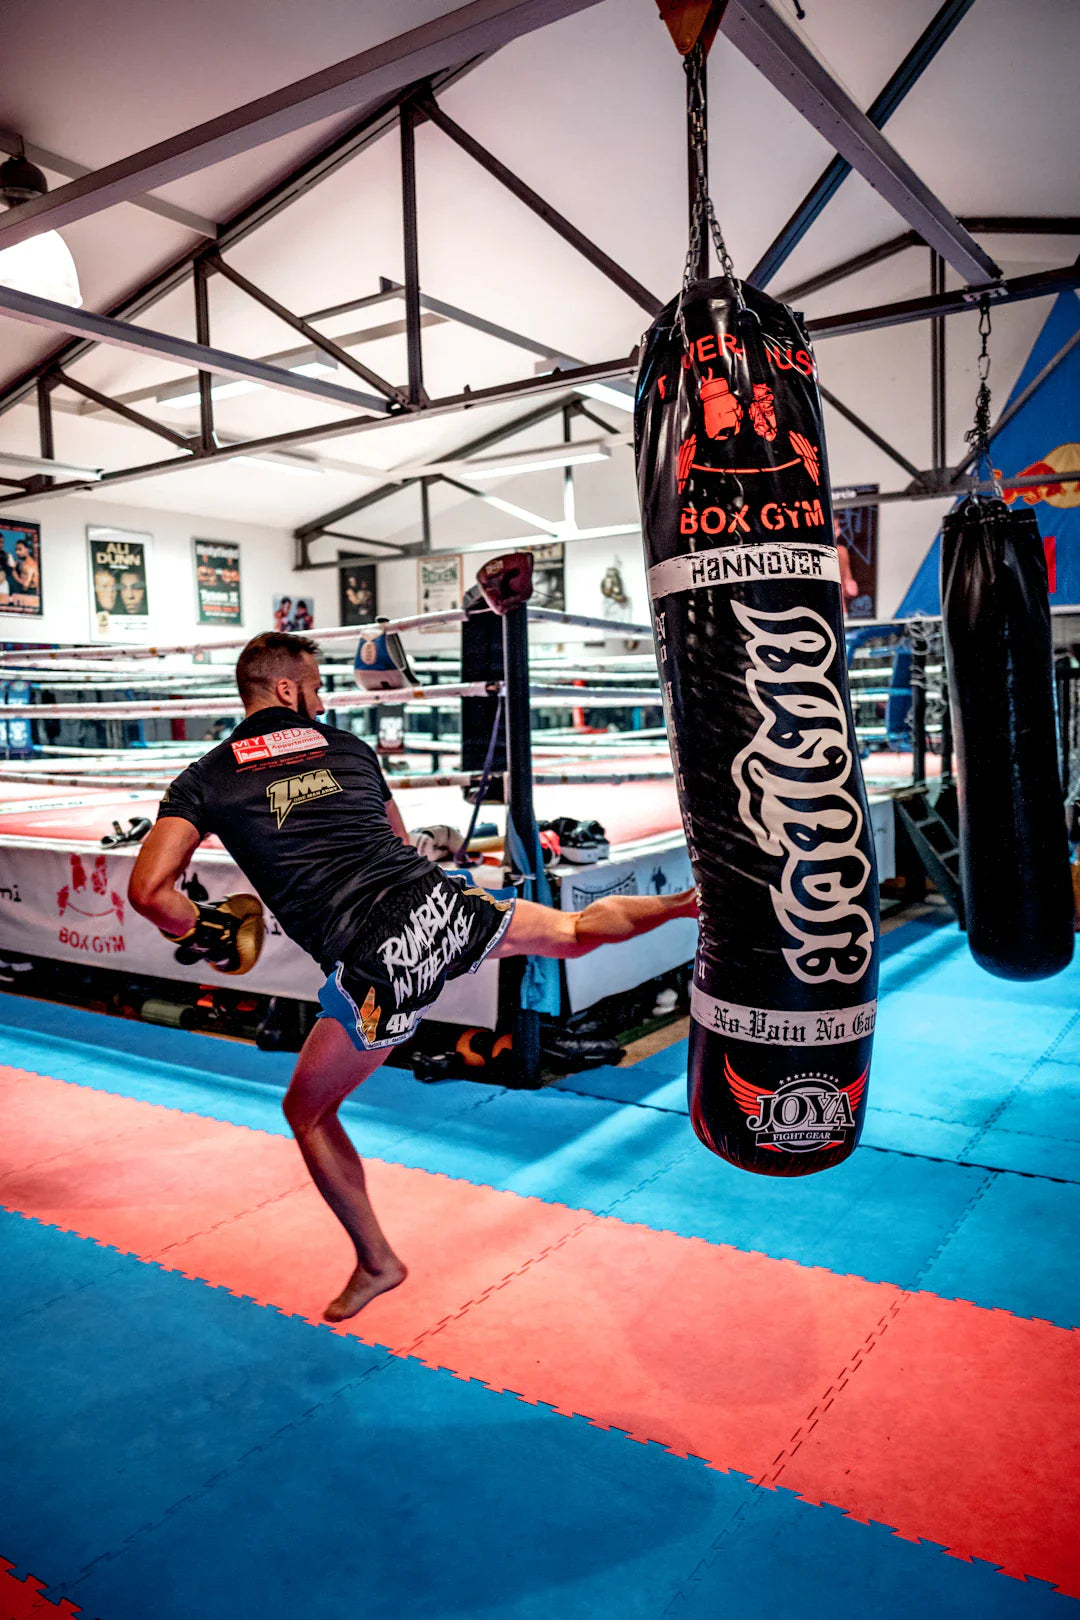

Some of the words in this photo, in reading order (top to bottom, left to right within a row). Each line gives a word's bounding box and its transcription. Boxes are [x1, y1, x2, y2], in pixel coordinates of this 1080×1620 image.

[680, 505, 751, 535] BOX
[760, 499, 825, 531] GYM
[96, 552, 141, 567] DUNN
[105, 542, 130, 555] ALI
[232, 736, 261, 750] MY
[58, 927, 90, 952] BOX
[92, 934, 126, 953] GYM
[376, 882, 459, 983] RUMBLE
[393, 966, 413, 1010] IN
[410, 948, 446, 997] THE
[713, 1005, 741, 1034] No
[749, 1009, 806, 1043] Pain
[814, 1017, 846, 1042] No
[852, 1008, 876, 1036] Gai
[746, 1091, 856, 1132] JOYA
[772, 1132, 805, 1142] FIGHT
[805, 1131, 831, 1141] GEAR
